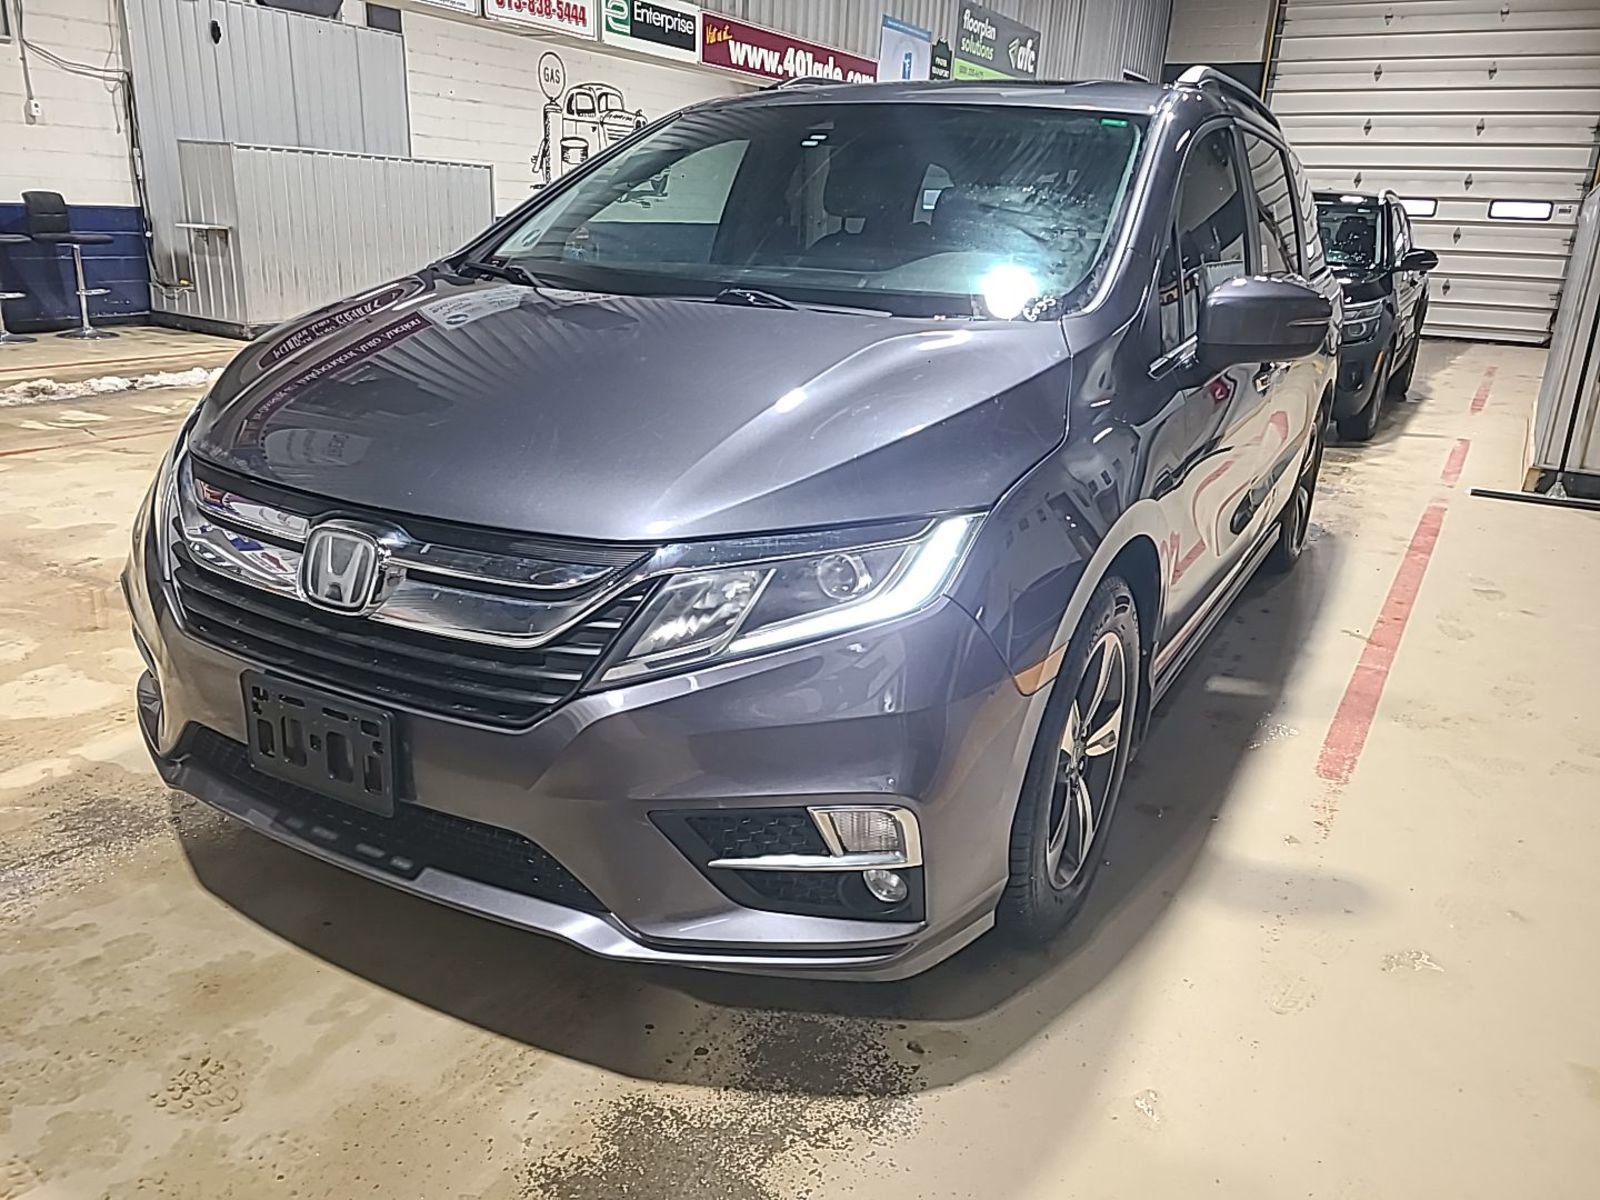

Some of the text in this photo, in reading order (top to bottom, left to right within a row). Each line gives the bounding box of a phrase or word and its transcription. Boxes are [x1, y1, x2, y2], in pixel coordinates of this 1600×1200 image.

[633, 3, 695, 35] Enterprise
[963, 8, 997, 41] floorplan
[728, 40, 874, 83] www.401adecom
[961, 34, 994, 61] solutions
[543, 66, 560, 84] GAS
